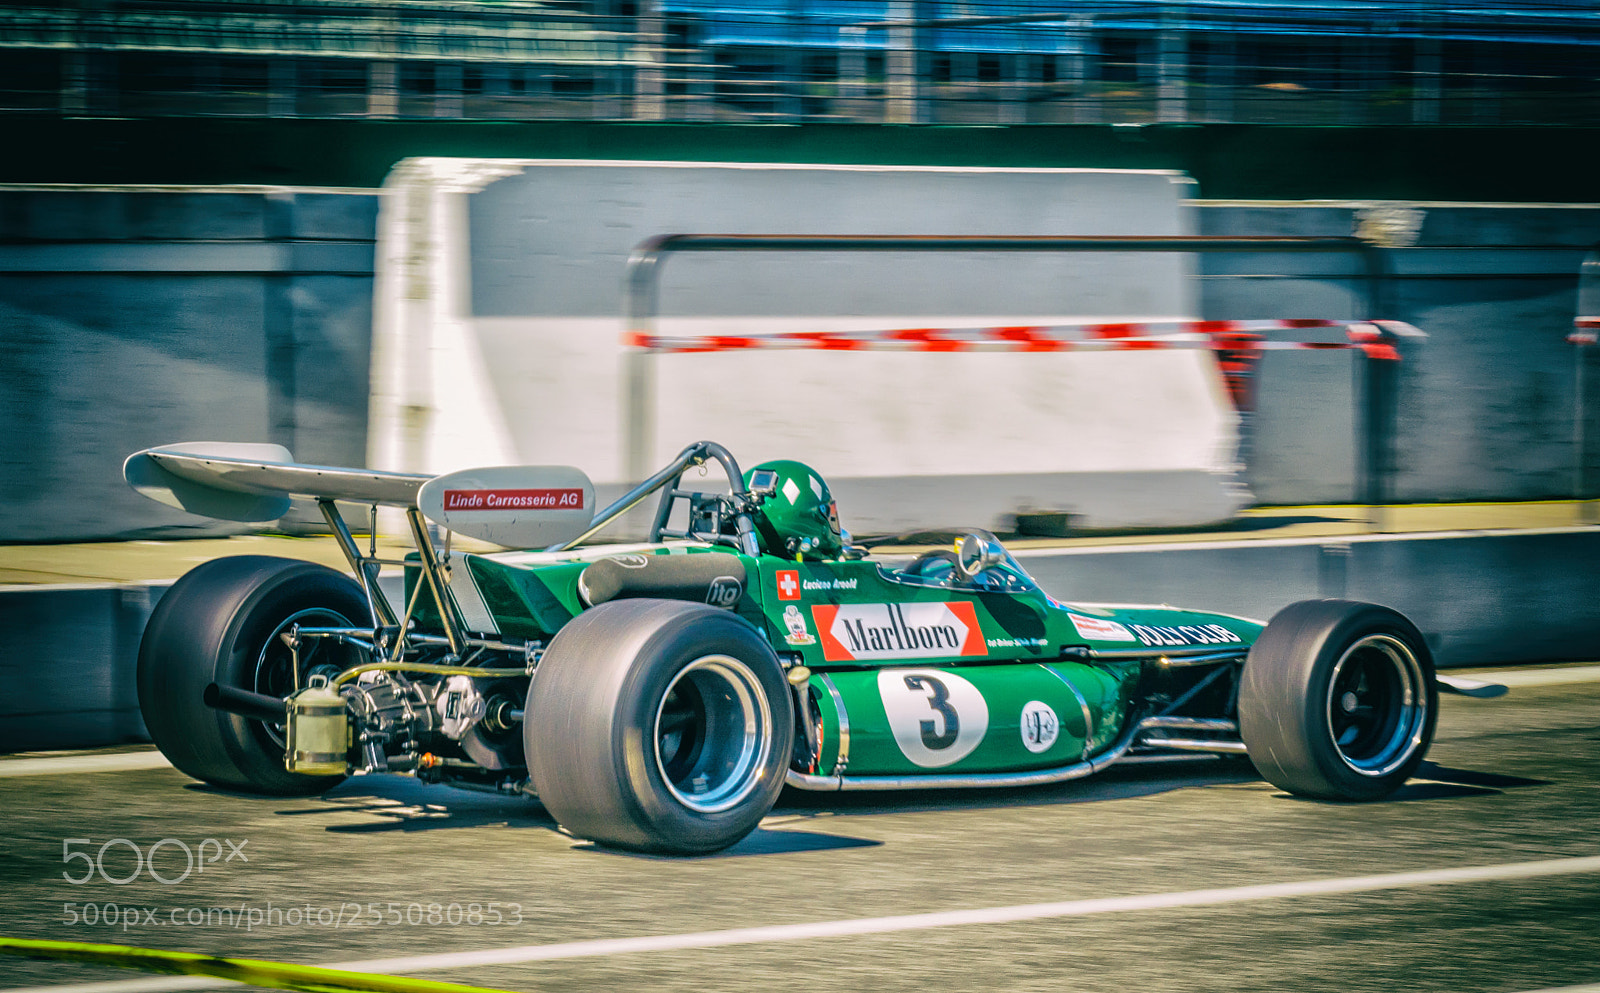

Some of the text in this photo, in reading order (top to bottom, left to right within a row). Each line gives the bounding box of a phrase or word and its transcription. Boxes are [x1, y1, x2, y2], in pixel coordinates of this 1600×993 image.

[449, 493, 578, 507] Linde Carrosserie AG
[842, 603, 960, 652] Marlboro
[1127, 623, 1191, 647] JOLLY
[1178, 624, 1242, 645] CLUB
[903, 674, 959, 750] 3
